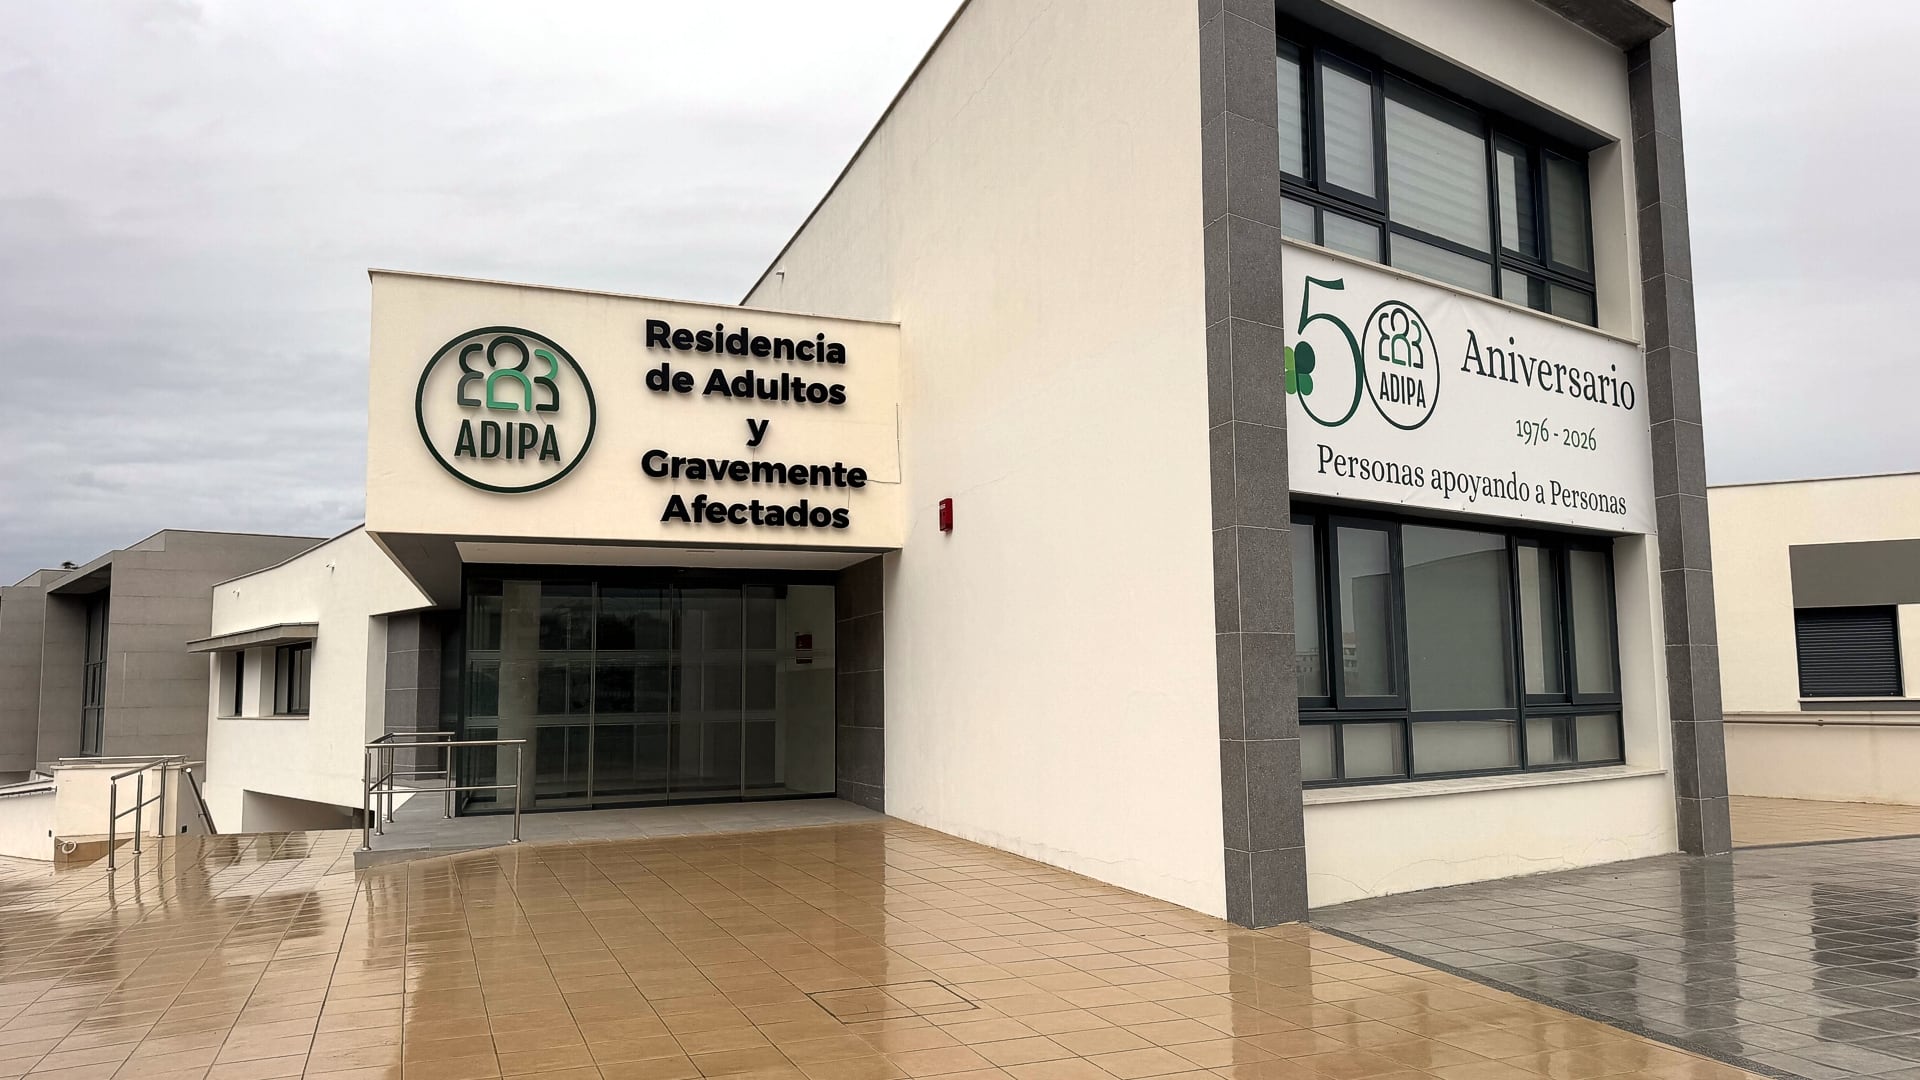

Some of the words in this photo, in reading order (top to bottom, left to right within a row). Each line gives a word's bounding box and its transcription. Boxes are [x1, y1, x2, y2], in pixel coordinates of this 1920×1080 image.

[646, 319, 846, 364] Residencia
[646, 364, 694, 395] de
[703, 368, 846, 405] Adultos
[1460, 329, 1635, 412] Aniversario
[1379, 372, 1427, 409] ADIPA
[454, 419, 561, 462] ADIPA
[746, 418, 769, 447] y
[1516, 418, 1549, 446] 1976
[1563, 427, 1597, 452] 2026
[641, 450, 867, 488] Gravemente
[1317, 444, 1425, 488] Personas
[1431, 468, 1530, 503] apoyando
[1535, 486, 1546, 504] a
[1550, 480, 1627, 516] Personas
[661, 495, 850, 529] Afectados
